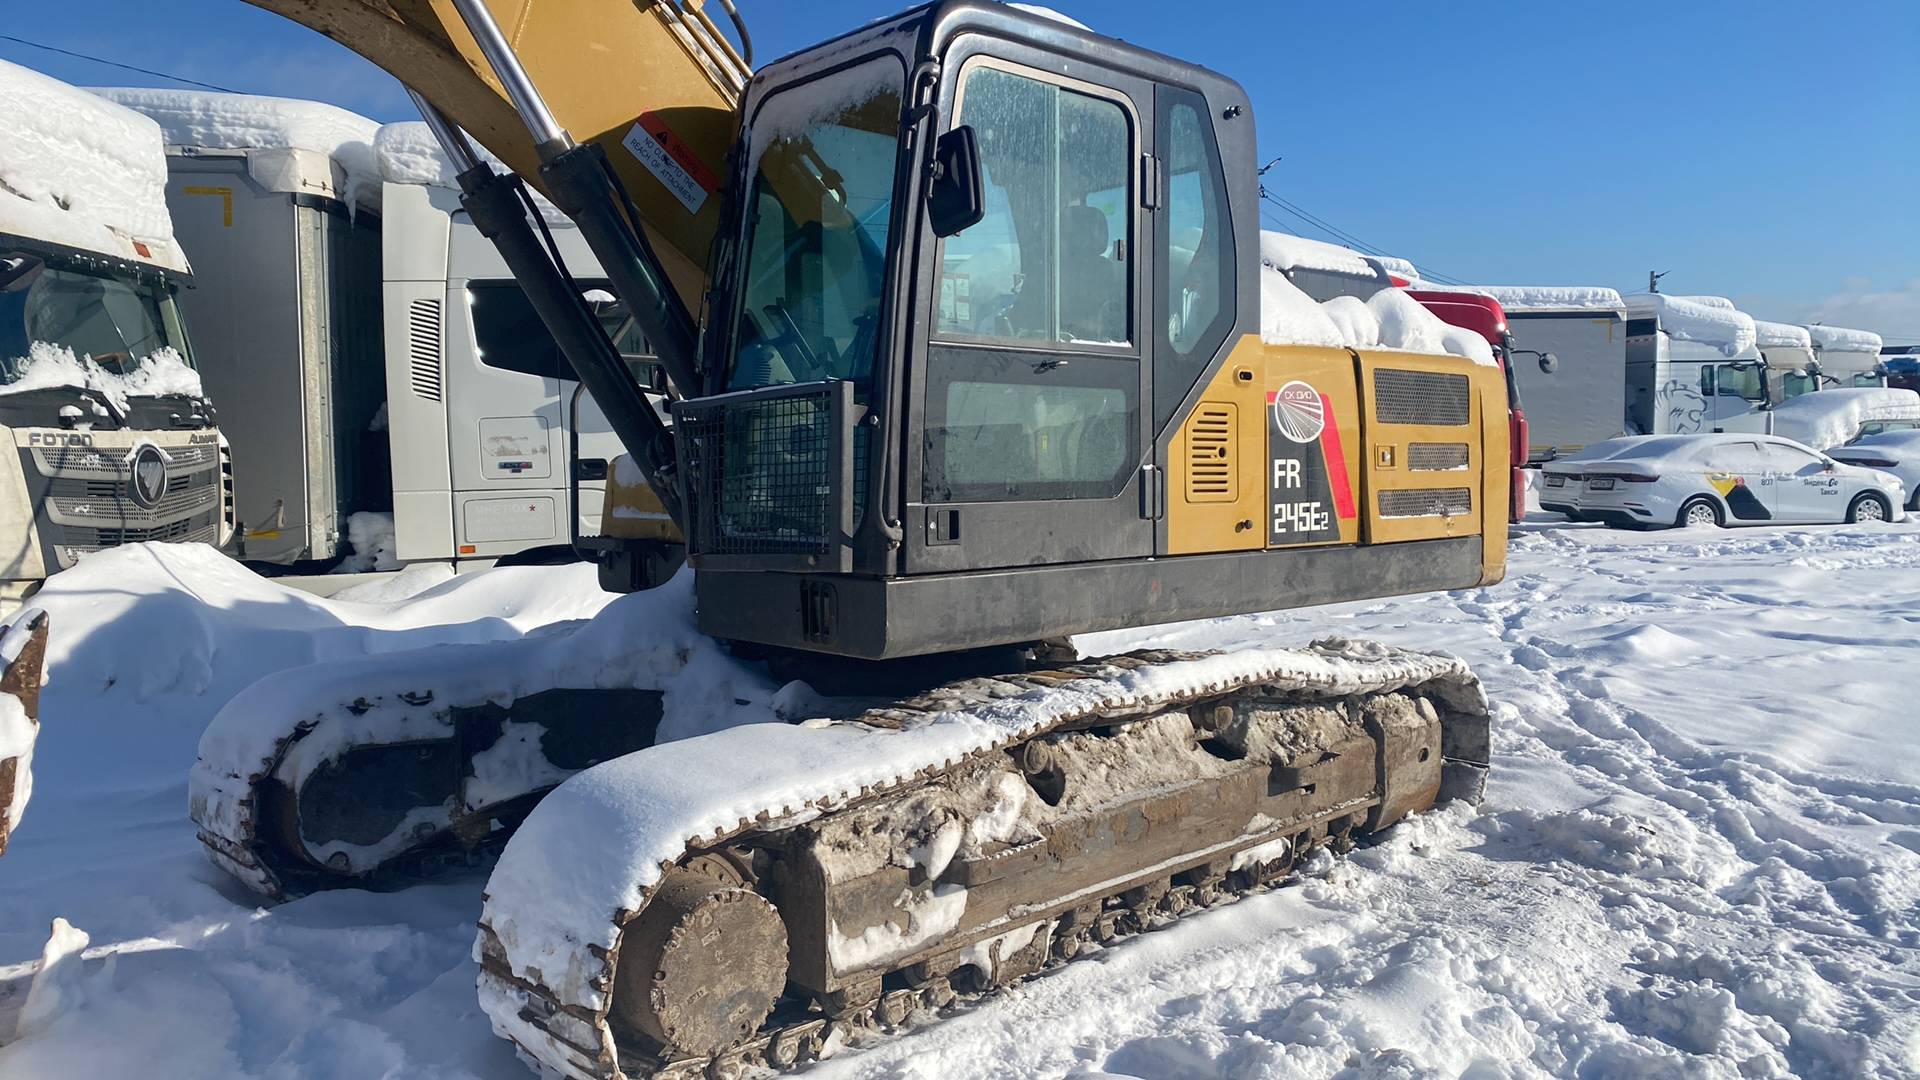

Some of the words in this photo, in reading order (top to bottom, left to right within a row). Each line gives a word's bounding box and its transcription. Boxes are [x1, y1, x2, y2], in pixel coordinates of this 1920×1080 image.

[631, 138, 651, 160] REACH
[651, 159, 661, 170] OF
[661, 169, 696, 204] ATTACHMENT
[643, 137, 654, 149] NO
[673, 165, 683, 178] TO
[683, 174, 696, 191] THE
[29, 433, 93, 446] FOTON
[1274, 458, 1301, 489] FR
